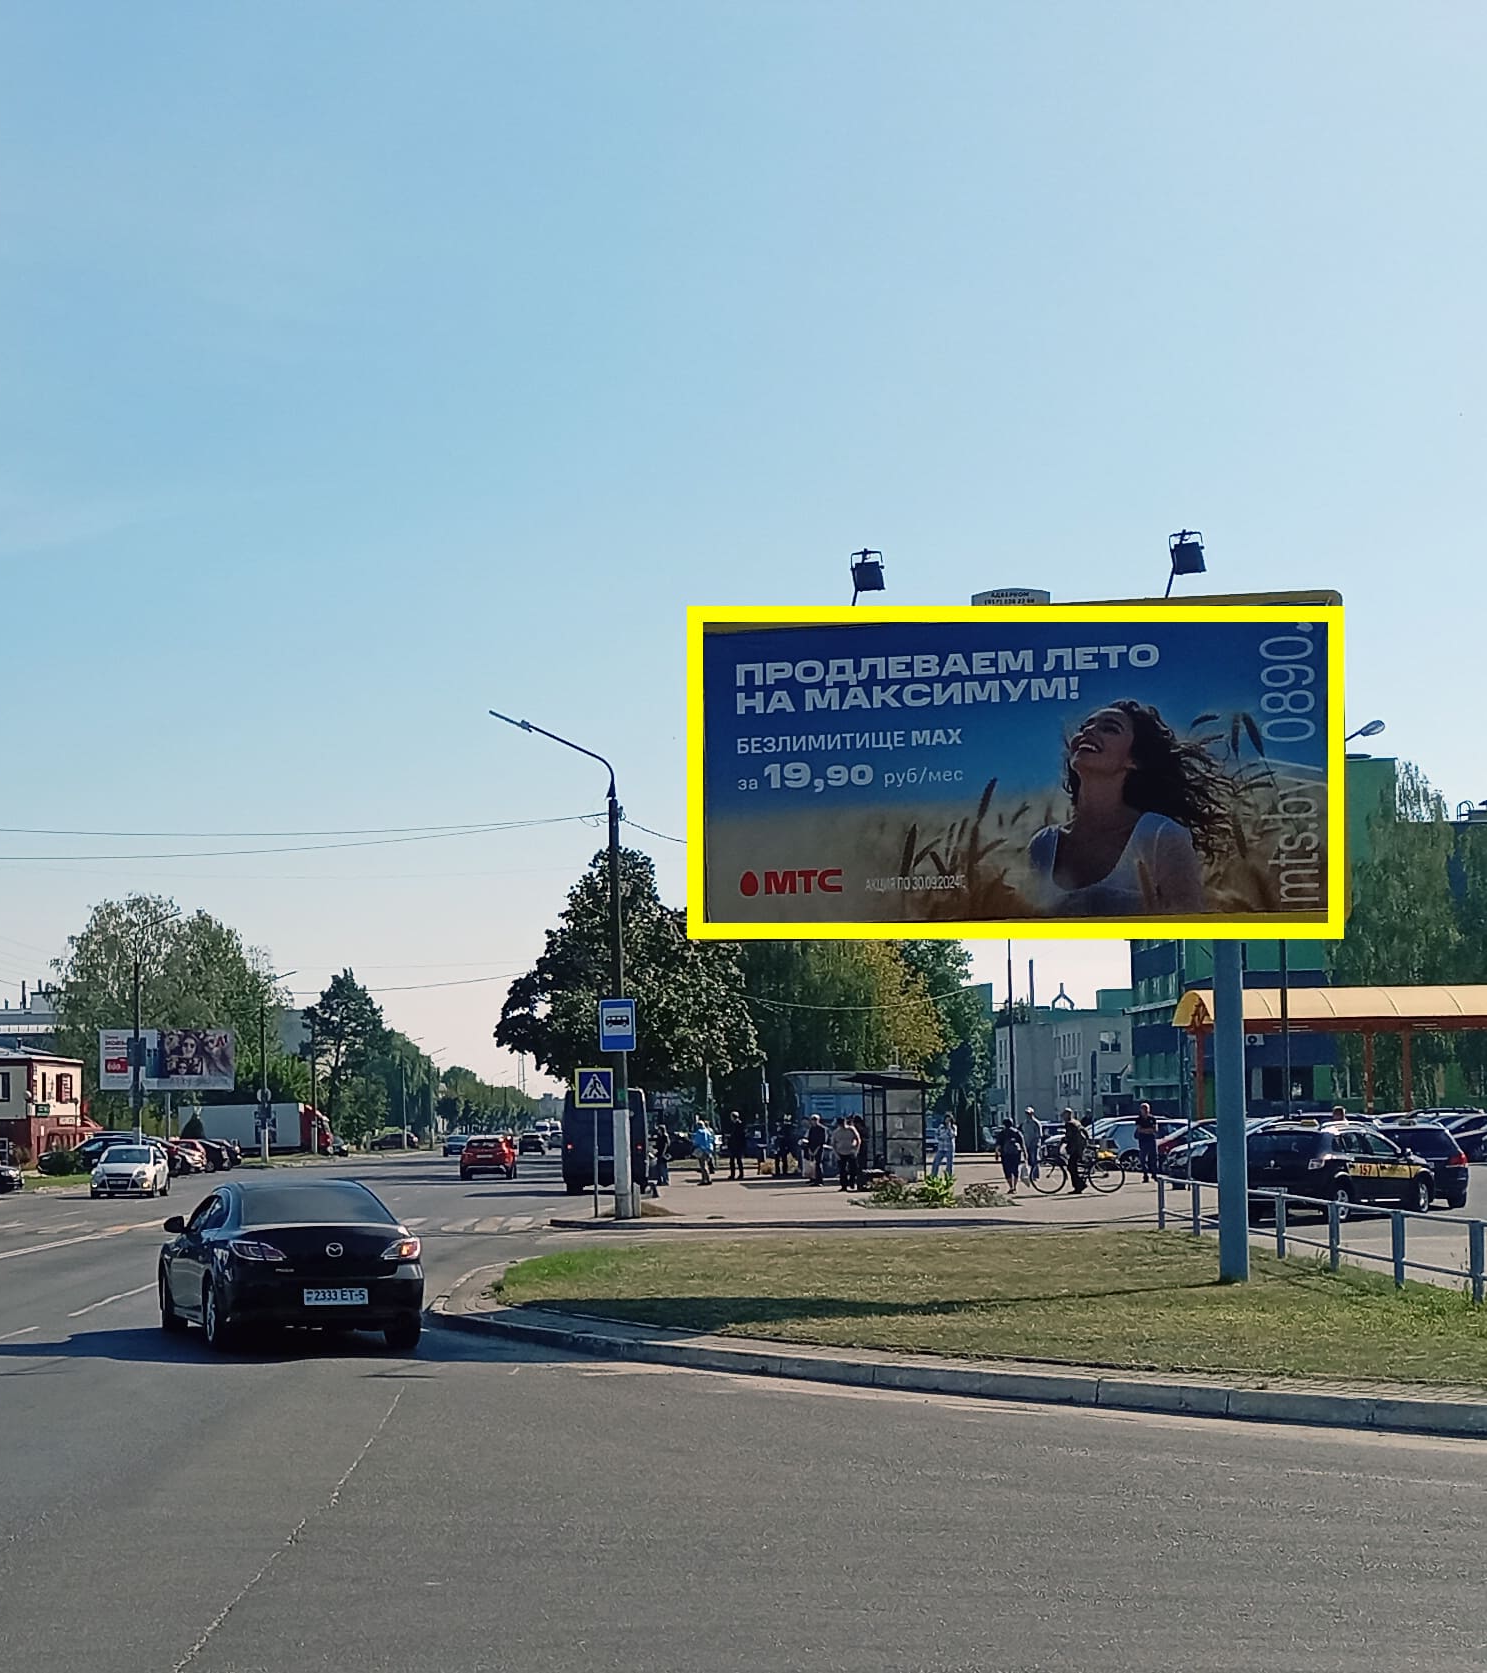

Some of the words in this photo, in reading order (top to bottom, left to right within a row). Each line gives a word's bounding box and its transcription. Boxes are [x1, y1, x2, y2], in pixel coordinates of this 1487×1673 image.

[736, 649, 1034, 687] ПРОДЛЕВАЕМ
[1043, 643, 1160, 672] ЛЕТО
[736, 690, 796, 715] НА
[804, 676, 1080, 712] МАКСИМУМ!
[1259, 635, 1316, 743] 0890
[736, 730, 906, 755] БЕЗЛИМИТИЩЕ
[911, 728, 963, 747] MAX
[738, 779, 759, 791] за
[763, 761, 874, 793] 19,90
[884, 766, 964, 788] руб/мес
[765, 868, 843, 895] МТС
[898, 876, 911, 890] ПО
[1359, 1163, 1372, 1176] 157
